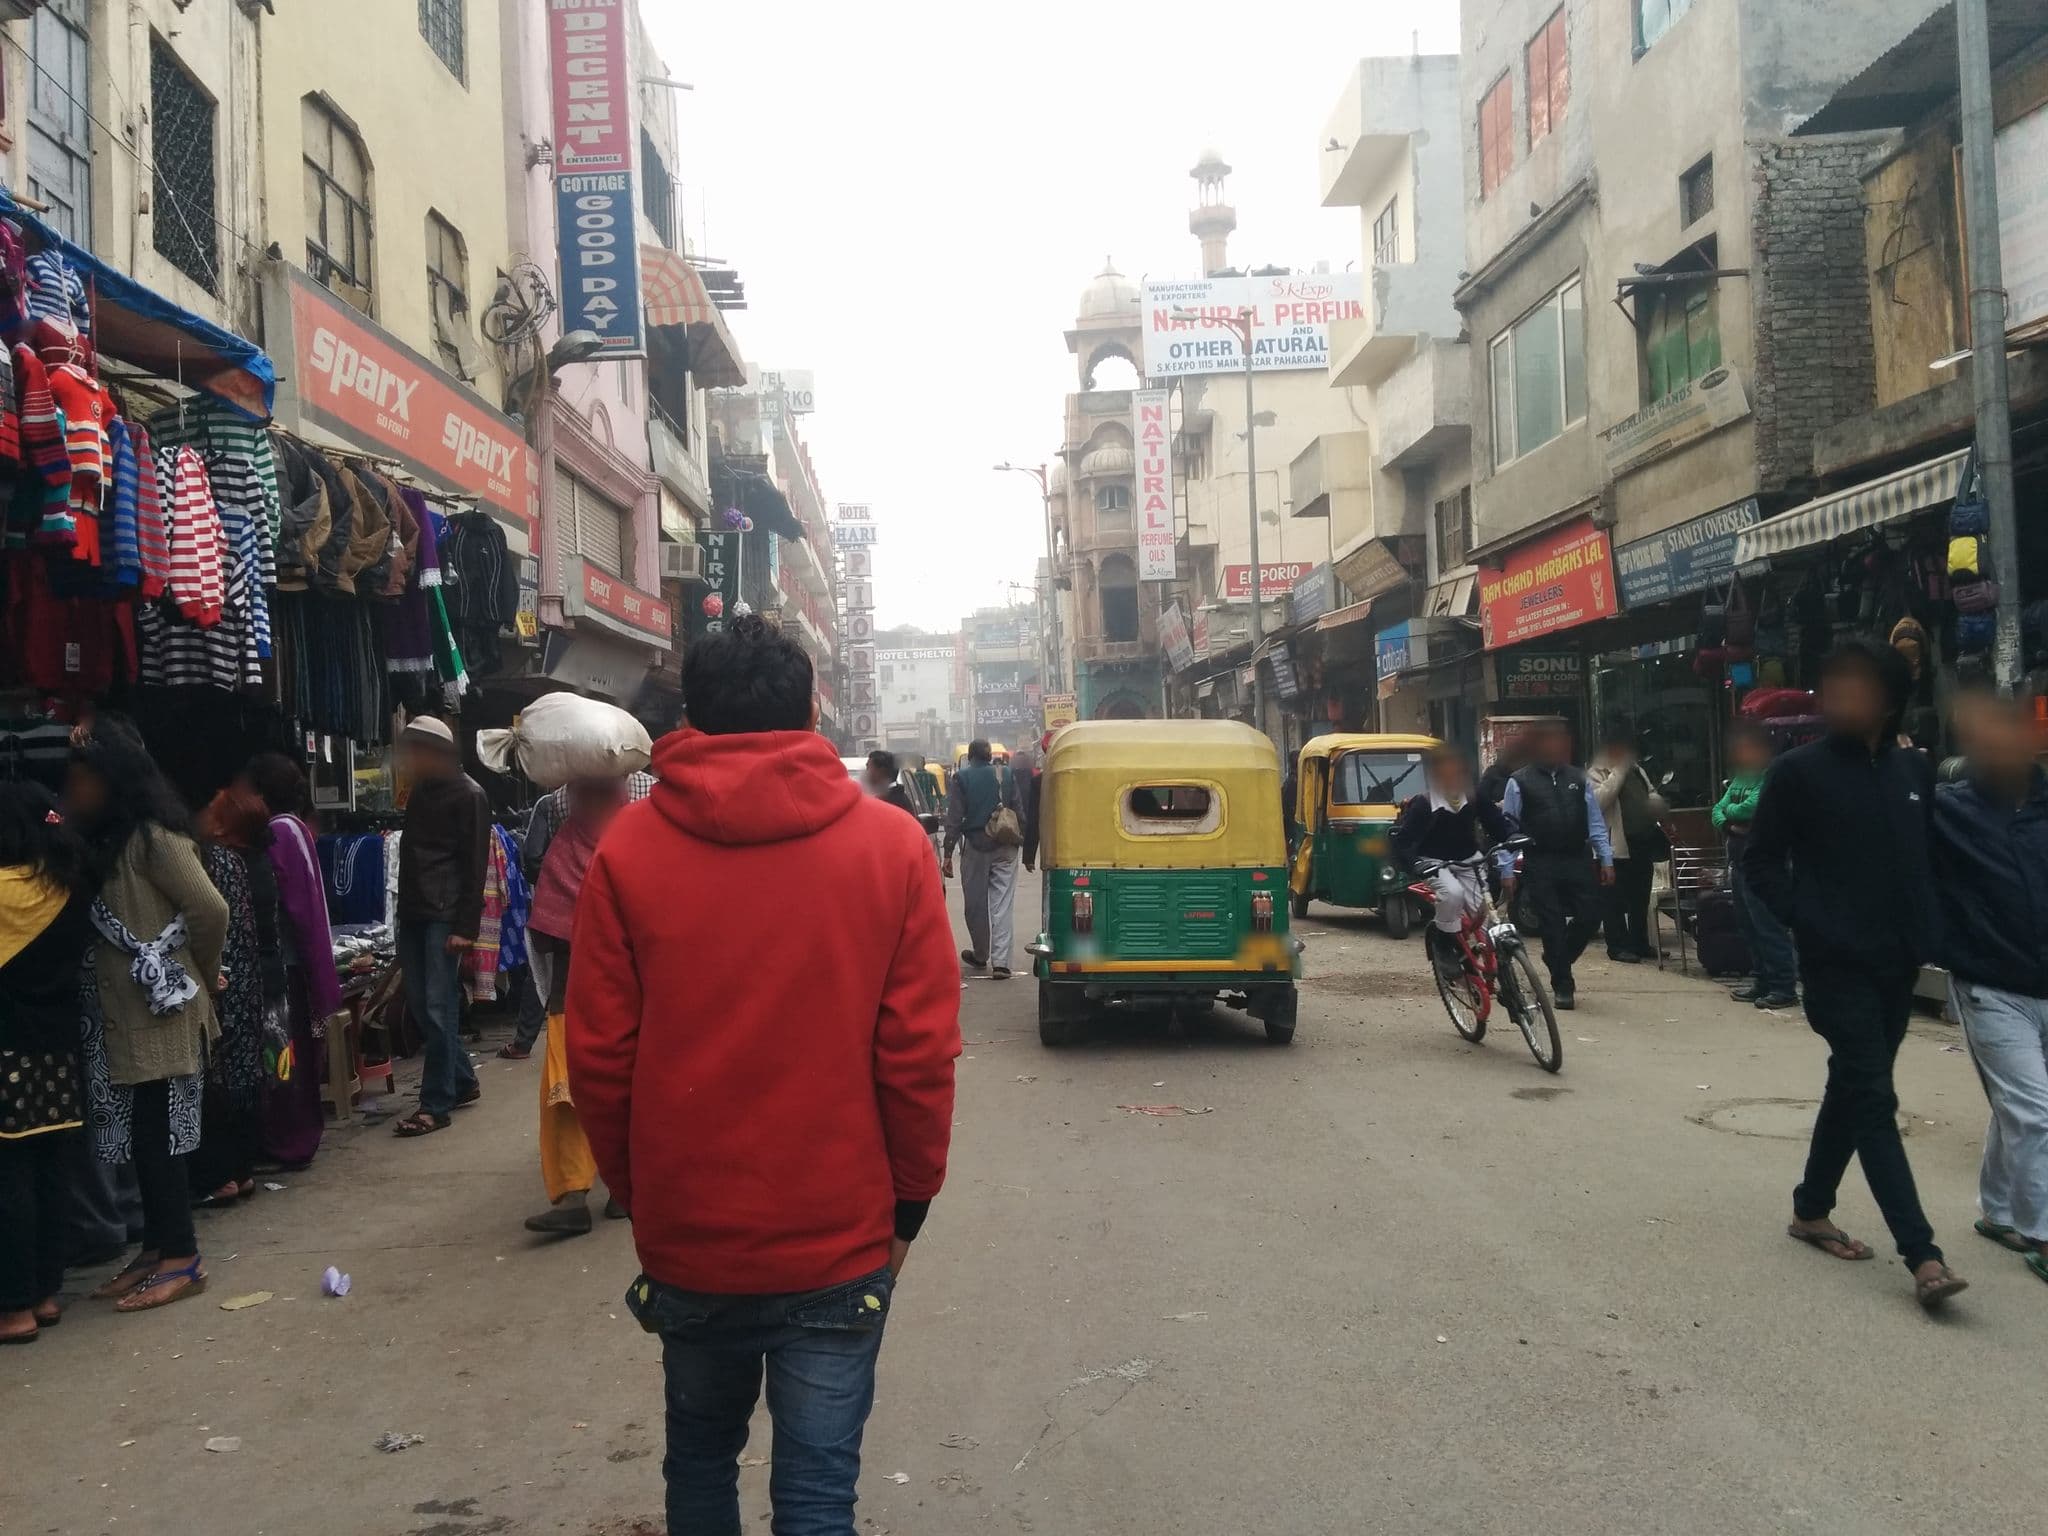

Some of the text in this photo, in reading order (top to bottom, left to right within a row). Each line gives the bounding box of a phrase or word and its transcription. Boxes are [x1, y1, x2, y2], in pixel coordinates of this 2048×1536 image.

[564, 12, 612, 144] DECENT
[566, 154, 620, 164] ENTRANCE
[560, 175, 626, 193] COTTAGE
[575, 195, 619, 329] GOOD DAY
[1149, 283, 1212, 293] MANUFACTURERS
[1161, 292, 1206, 301] EXPORTERS
[1292, 326, 1314, 336] AND
[1169, 335, 1328, 359] OTHER ATURAL
[1217, 358, 1239, 368] MAIN
[1274, 353, 1327, 365] PAHARGANJ
[310, 327, 419, 422] sparx
[377, 412, 410, 440] GO FOR IT
[442, 412, 518, 482] sparx
[1141, 405, 1167, 528] NATURAL
[839, 505, 870, 520] HOTEL
[836, 527, 877, 543] HARI
[1668, 505, 1753, 552] STANLEY OVERSEAS
[1141, 533, 1173, 546] PERFUME
[1149, 550, 1166, 562] OILS
[1240, 565, 1299, 585] EPORIO
[1483, 582, 1501, 604] RAM
[1503, 569, 1533, 596] CHAND
[1535, 549, 1582, 586] HARBANS
[1584, 541, 1604, 565] LAL
[1520, 585, 1563, 610] JEWELLERS
[875, 652, 910, 661] HOTEL
[1520, 658, 1580, 673] SONU
[1506, 673, 1551, 682] CHICKEN
